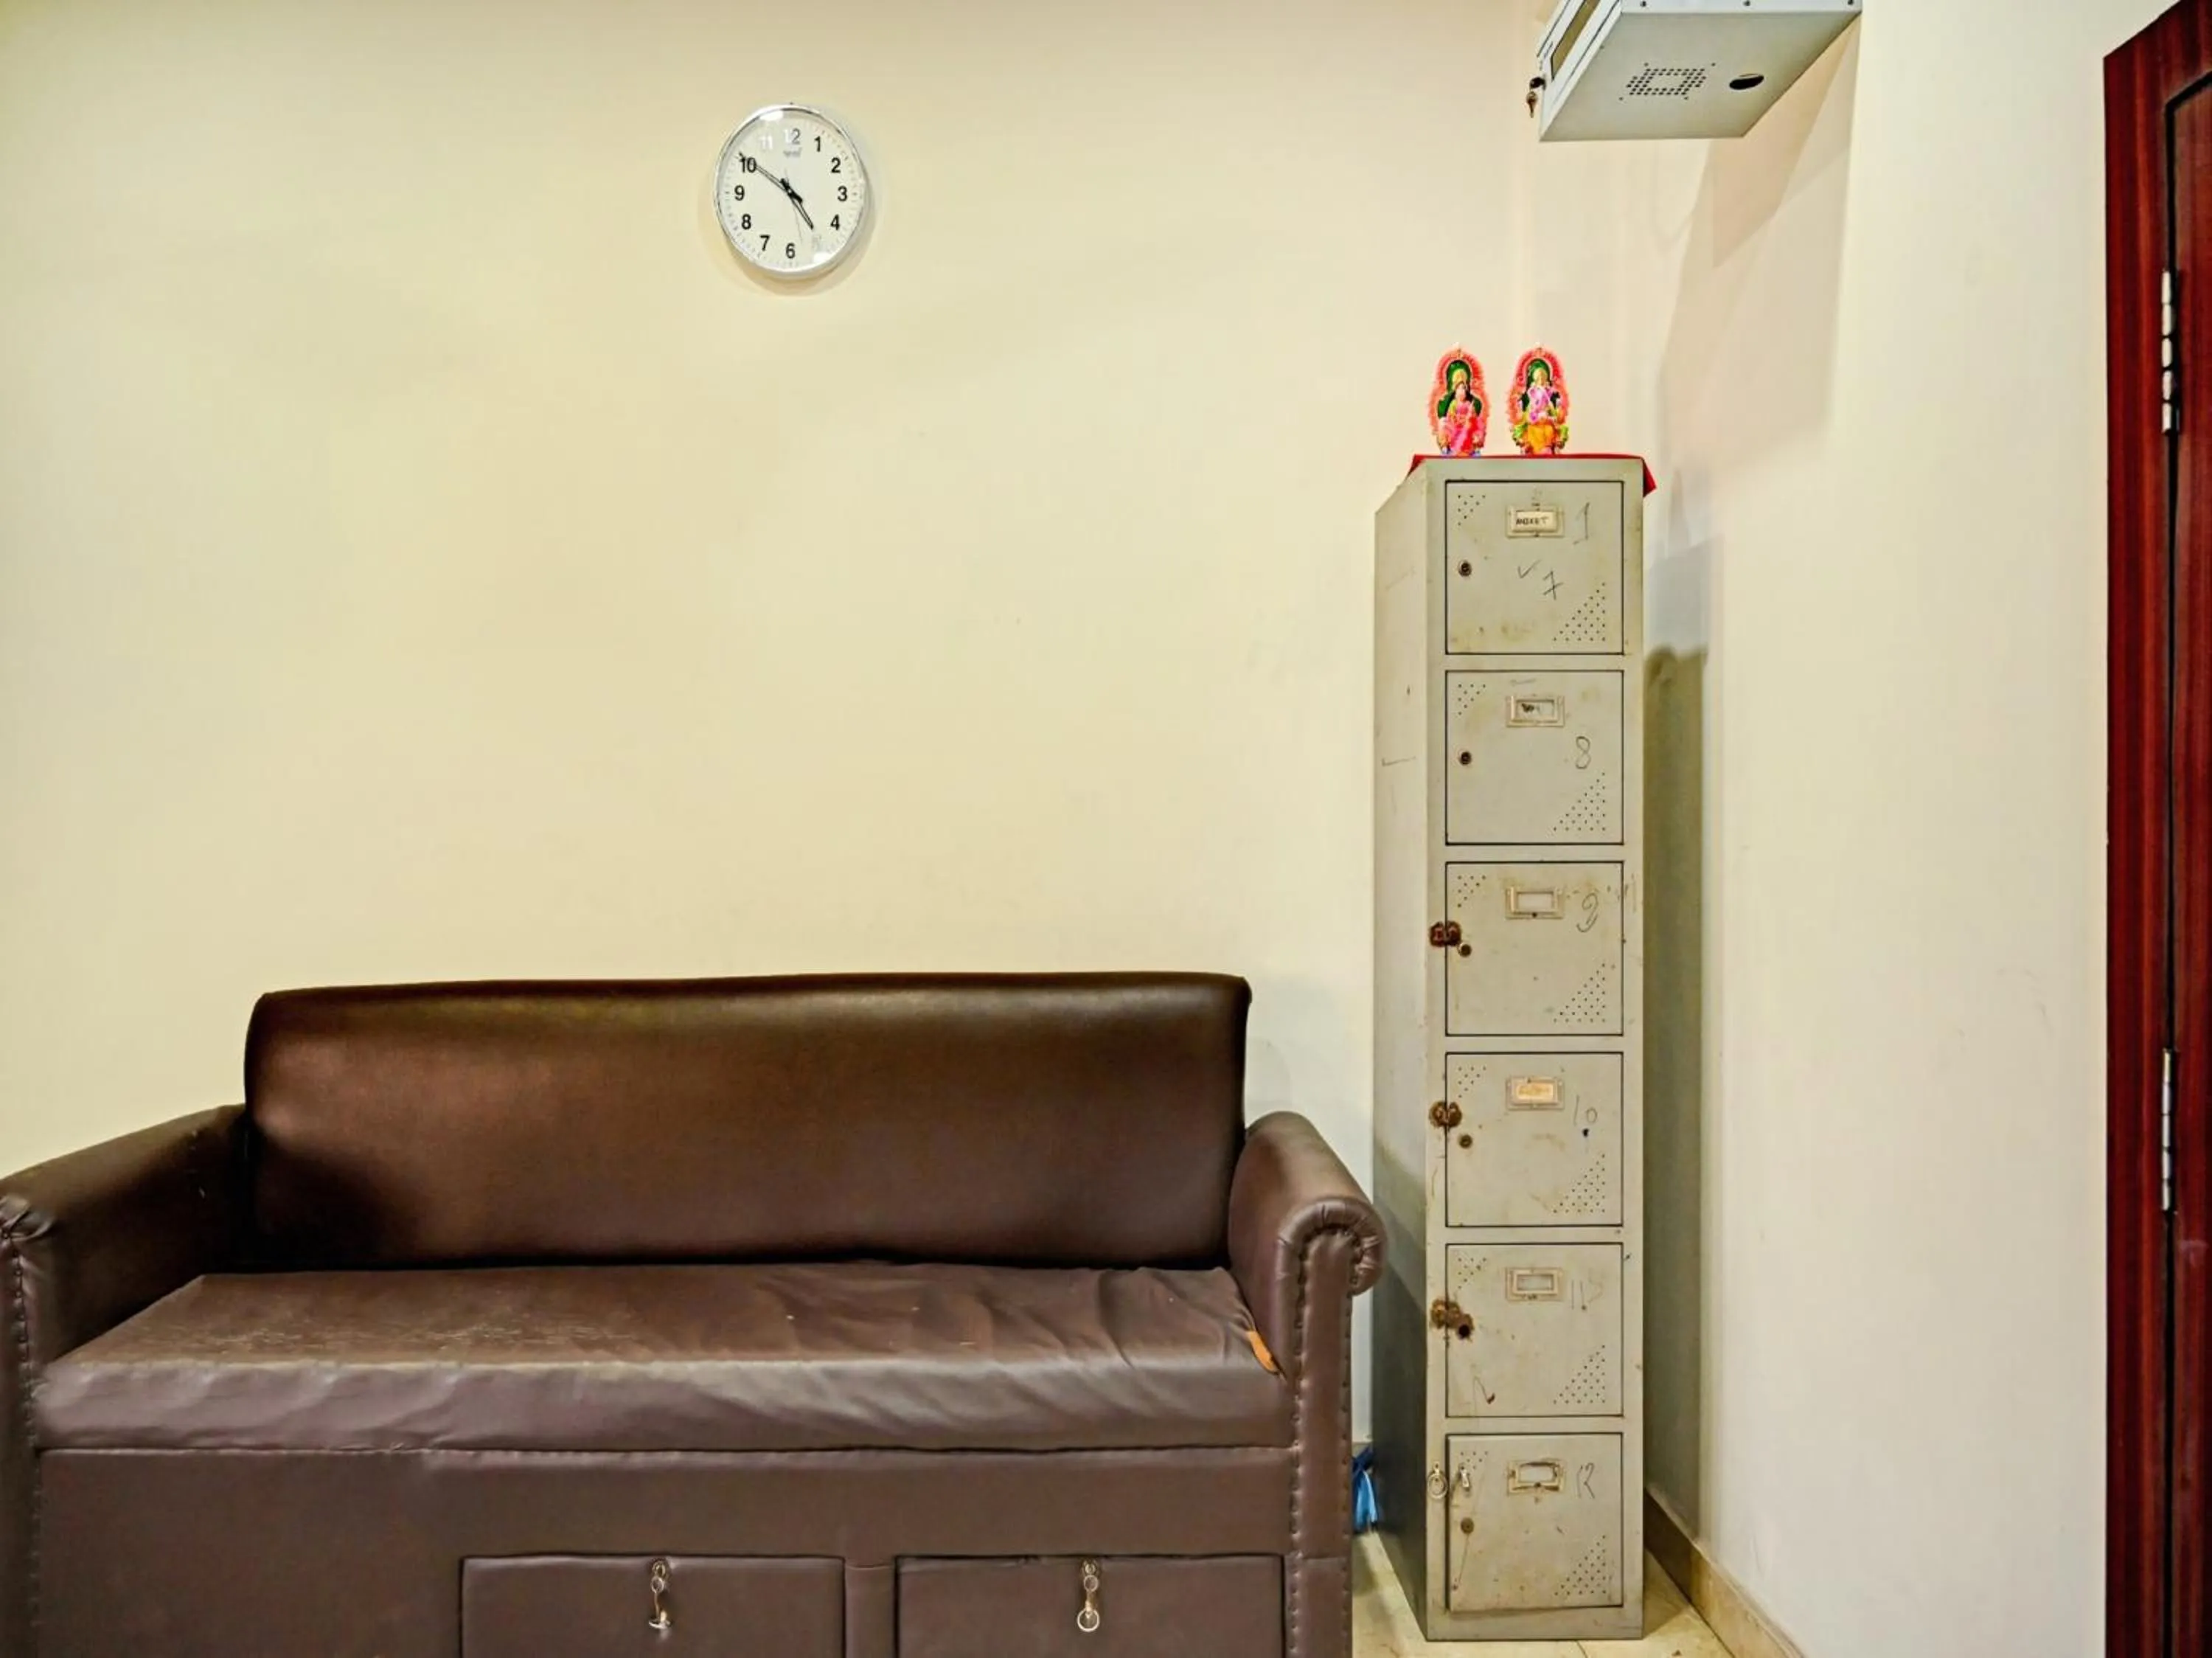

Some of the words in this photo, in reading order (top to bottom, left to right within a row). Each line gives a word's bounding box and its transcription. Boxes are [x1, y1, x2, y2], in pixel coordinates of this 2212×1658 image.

[814, 136, 821, 152] 1
[740, 156, 757, 173] 10
[831, 157, 841, 173] 2
[734, 185, 745, 201] 9
[838, 186, 848, 201] 3
[742, 214, 751, 230] 8
[830, 215, 840, 230] 4
[760, 235, 771, 251] 7
[785, 243, 796, 259] 6
[1575, 736, 1592, 769] 8
[1576, 892, 1599, 933] 9
[1573, 1095, 1598, 1126] 10
